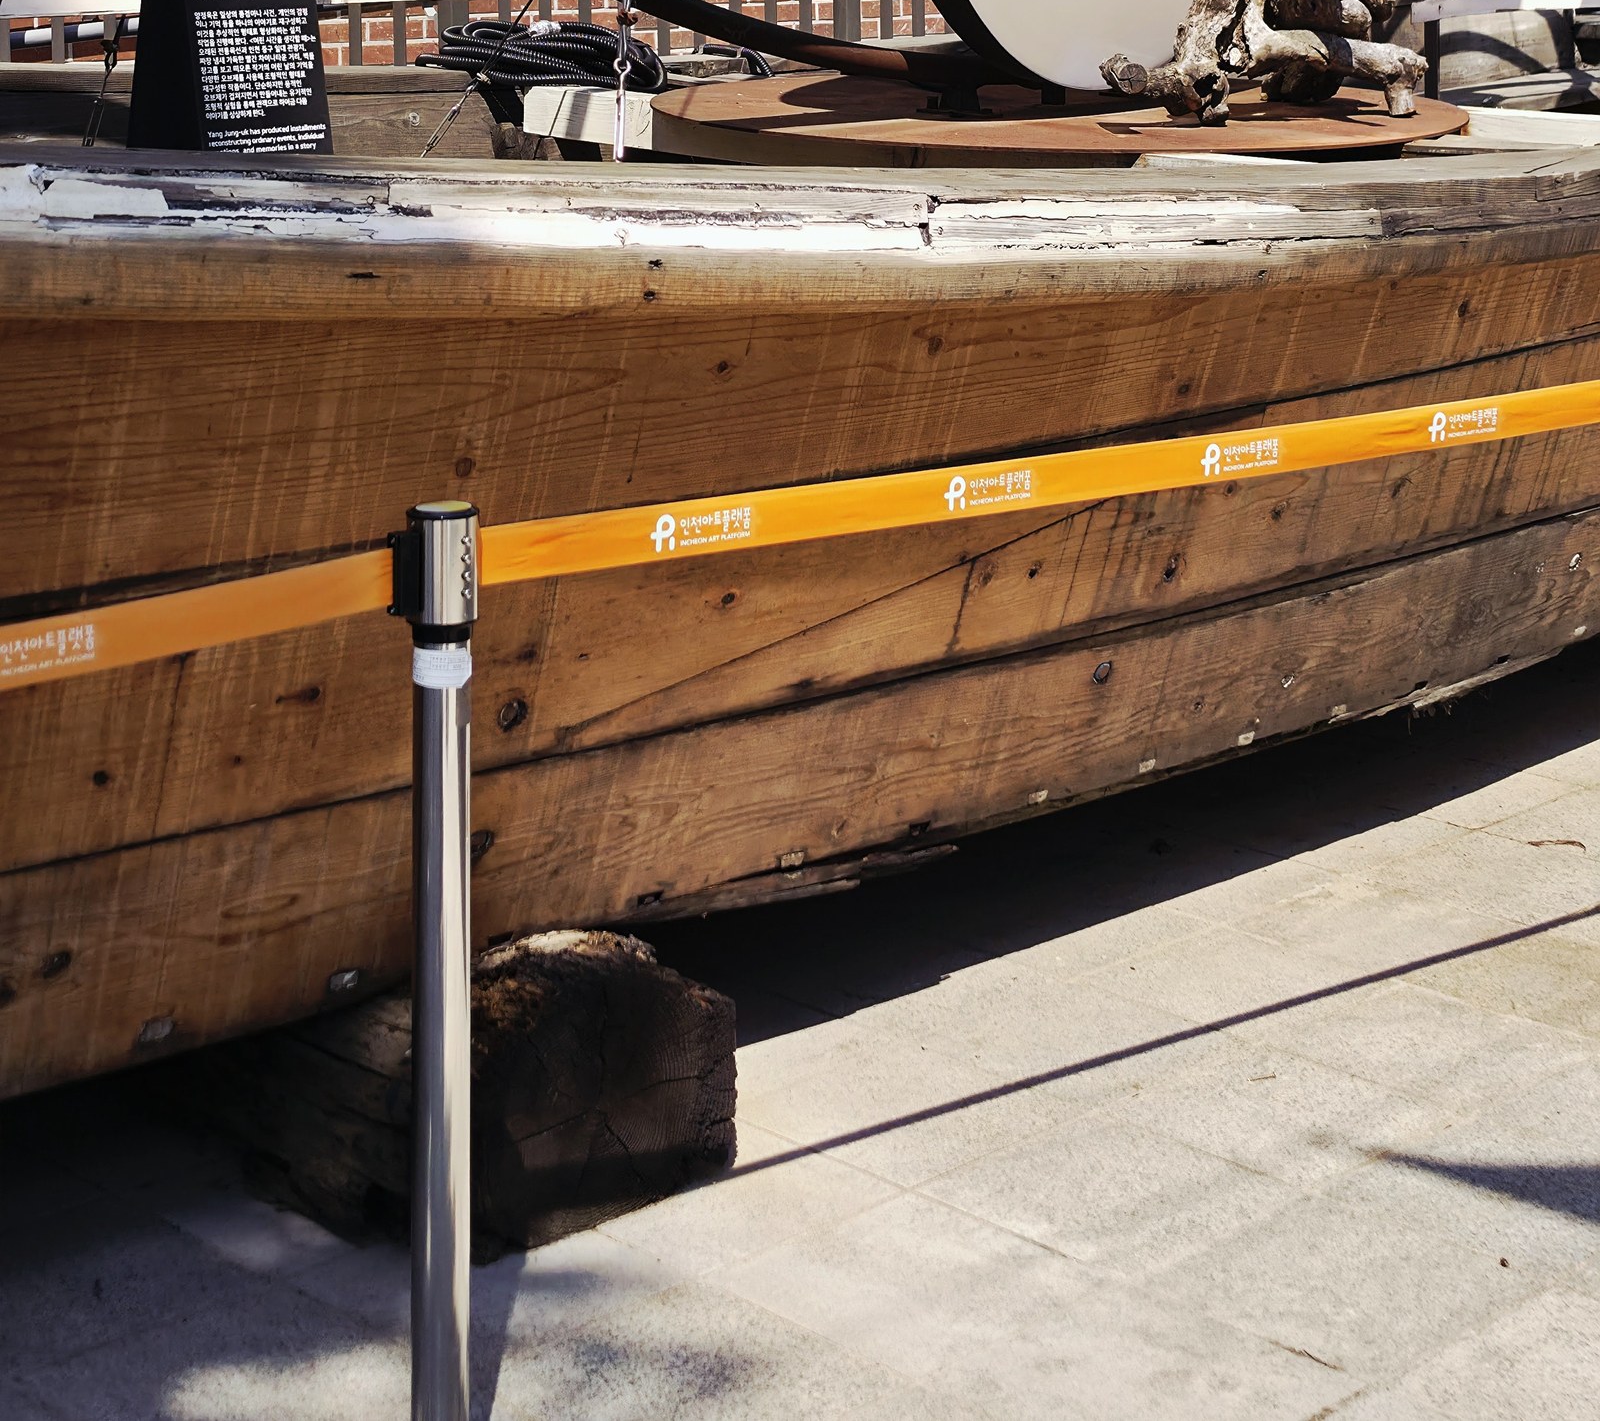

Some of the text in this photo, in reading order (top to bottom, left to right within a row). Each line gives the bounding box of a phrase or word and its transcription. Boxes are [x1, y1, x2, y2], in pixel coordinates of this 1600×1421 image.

[207, 131, 223, 139] Yang
[224, 128, 249, 138] Jung-uk
[261, 125, 289, 136] produced
[251, 136, 276, 144] ordinary
[242, 146, 255, 154] and
[255, 144, 287, 153] memories
[287, 142, 294, 150] in
[300, 142, 316, 150] story
[1448, 407, 1498, 429] 인천아트플랫폼
[1223, 438, 1278, 462] 인천아트플랫폼
[969, 470, 1031, 496] 인천아트플랫폼
[680, 507, 751, 535] 인천아트플랫폼
[680, 530, 751, 546] INCHEON ART PLATFORM
[0, 624, 95, 663] 인천아트플랫폼
